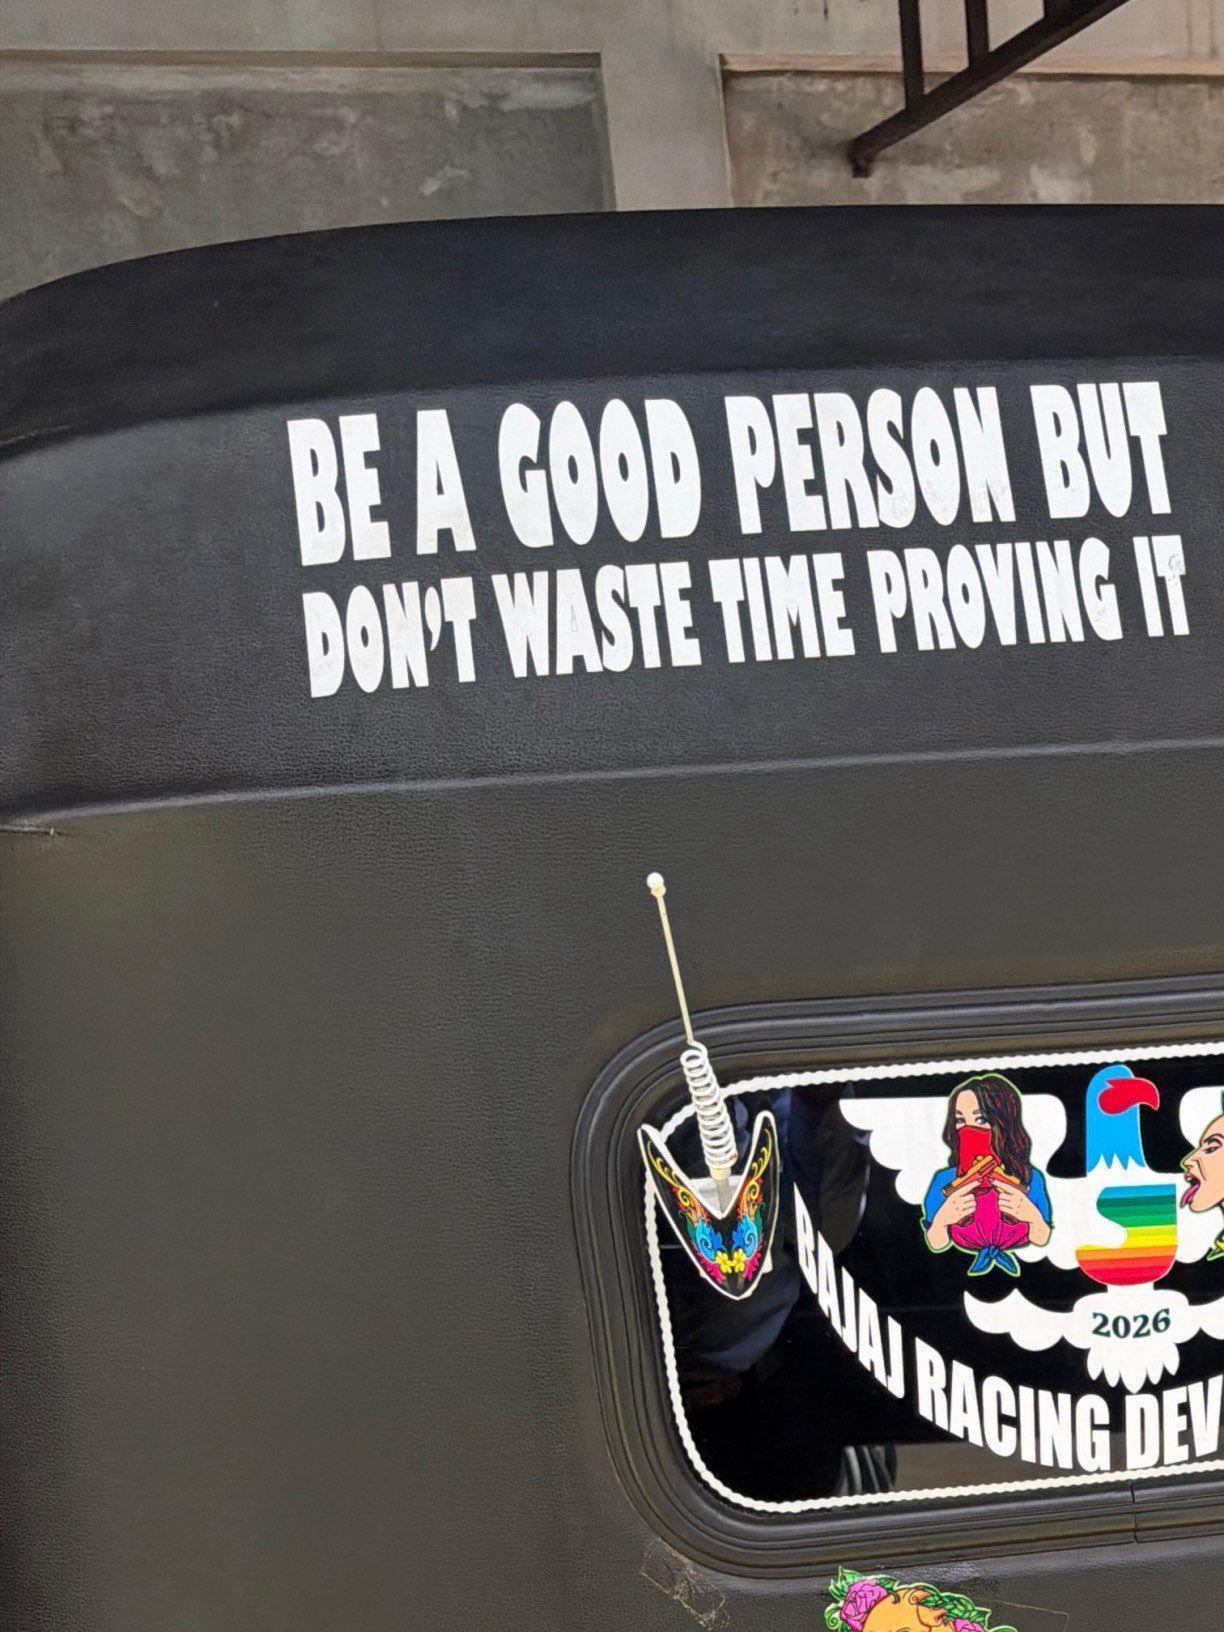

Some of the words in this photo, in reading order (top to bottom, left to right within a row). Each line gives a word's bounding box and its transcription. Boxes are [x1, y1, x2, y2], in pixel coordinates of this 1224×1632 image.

[287, 413, 391, 567] BE
[416, 408, 477, 555] A
[498, 398, 702, 549] GOOD
[724, 387, 1016, 535] PERSON
[1030, 381, 1172, 519] BUT
[491, 561, 702, 679] WASTE
[708, 552, 856, 664] TIME
[867, 537, 1123, 653] PROVING
[1133, 535, 1190, 637] IT
[794, 1181, 905, 1398] BAJAJ
[915, 1336, 1111, 1472] RACING
[1092, 1307, 1172, 1339] 2026
